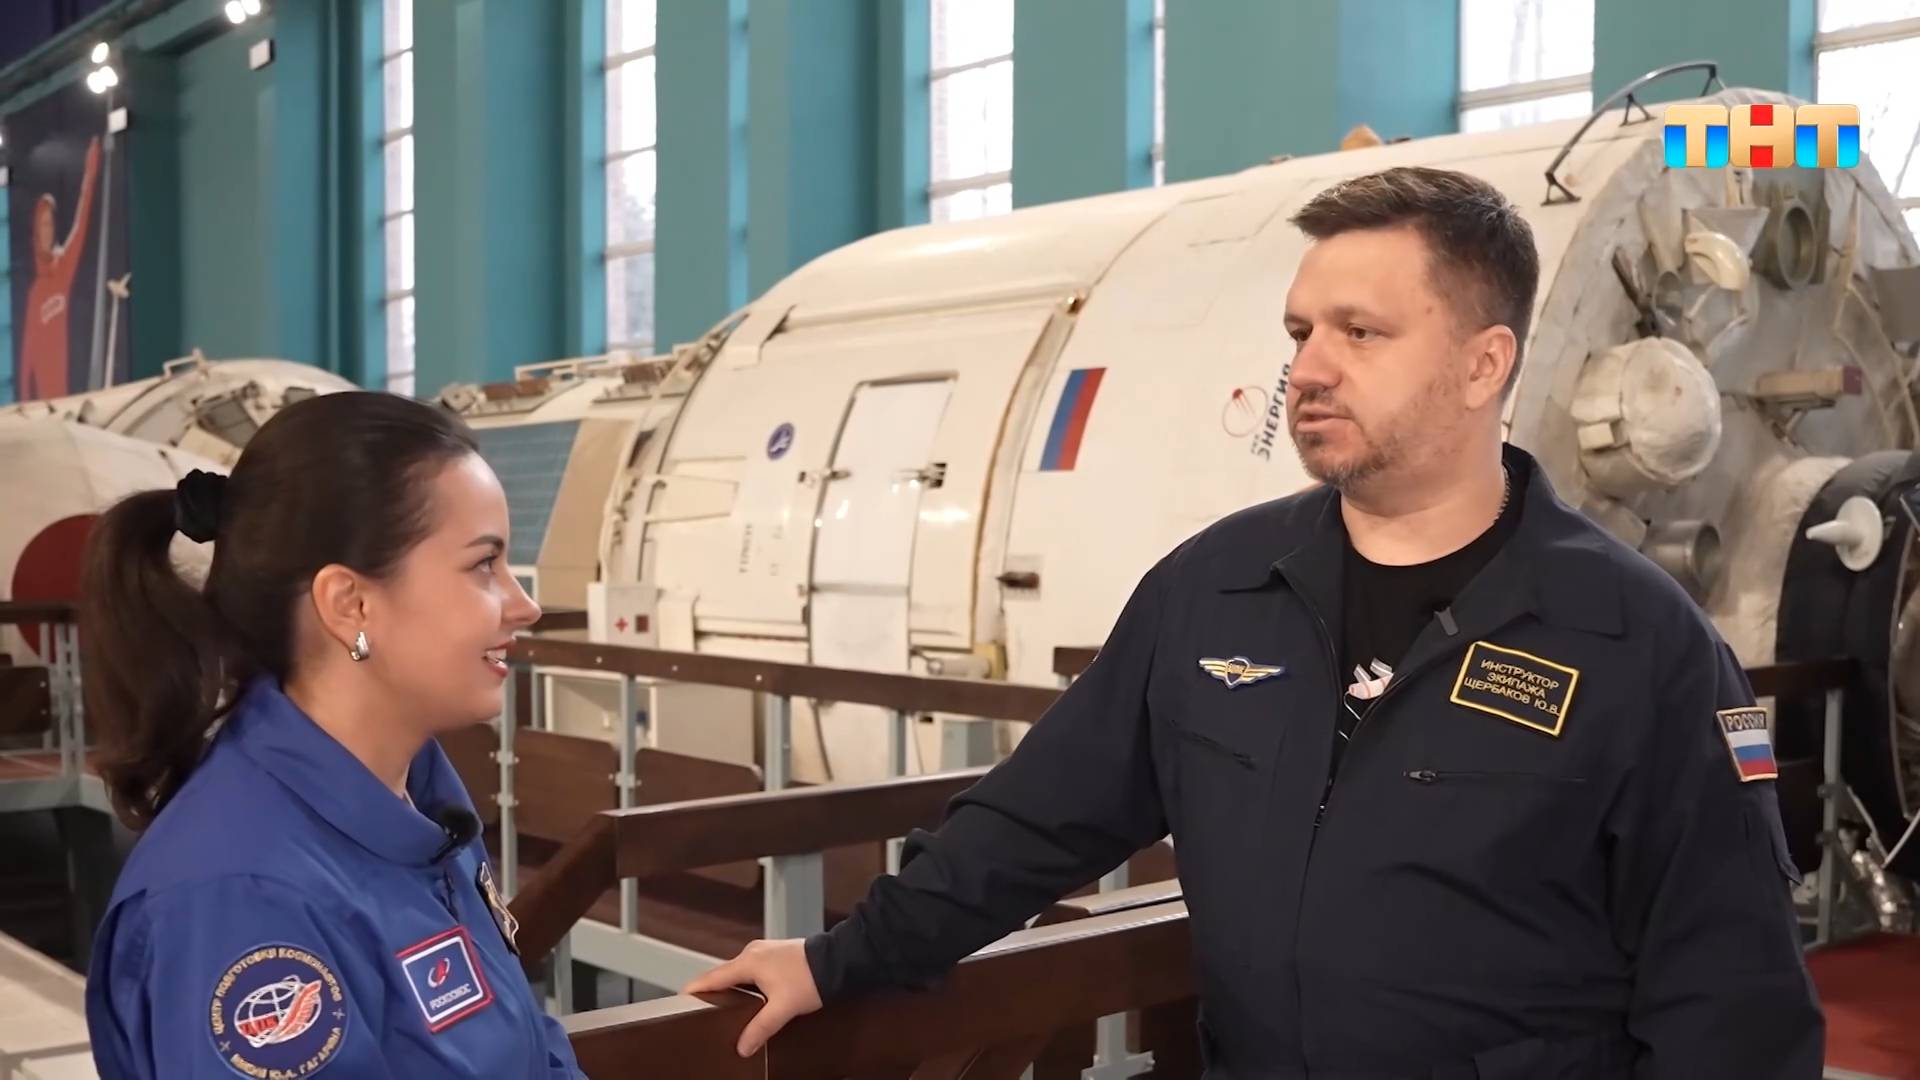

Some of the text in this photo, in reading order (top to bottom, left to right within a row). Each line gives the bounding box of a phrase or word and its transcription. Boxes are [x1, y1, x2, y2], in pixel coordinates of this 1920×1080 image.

[1480, 659, 1560, 690] ИНСТРУКТОР
[1487, 672, 1546, 699] ЭКИПАЖА
[1464, 677, 1531, 705] ЩЕРБАКОВ
[1725, 713, 1765, 731] РОССИЯ
[215, 948, 277, 998] ПОДГОТОВКИ
[299, 1027, 342, 1074] ГАГАРИНА
